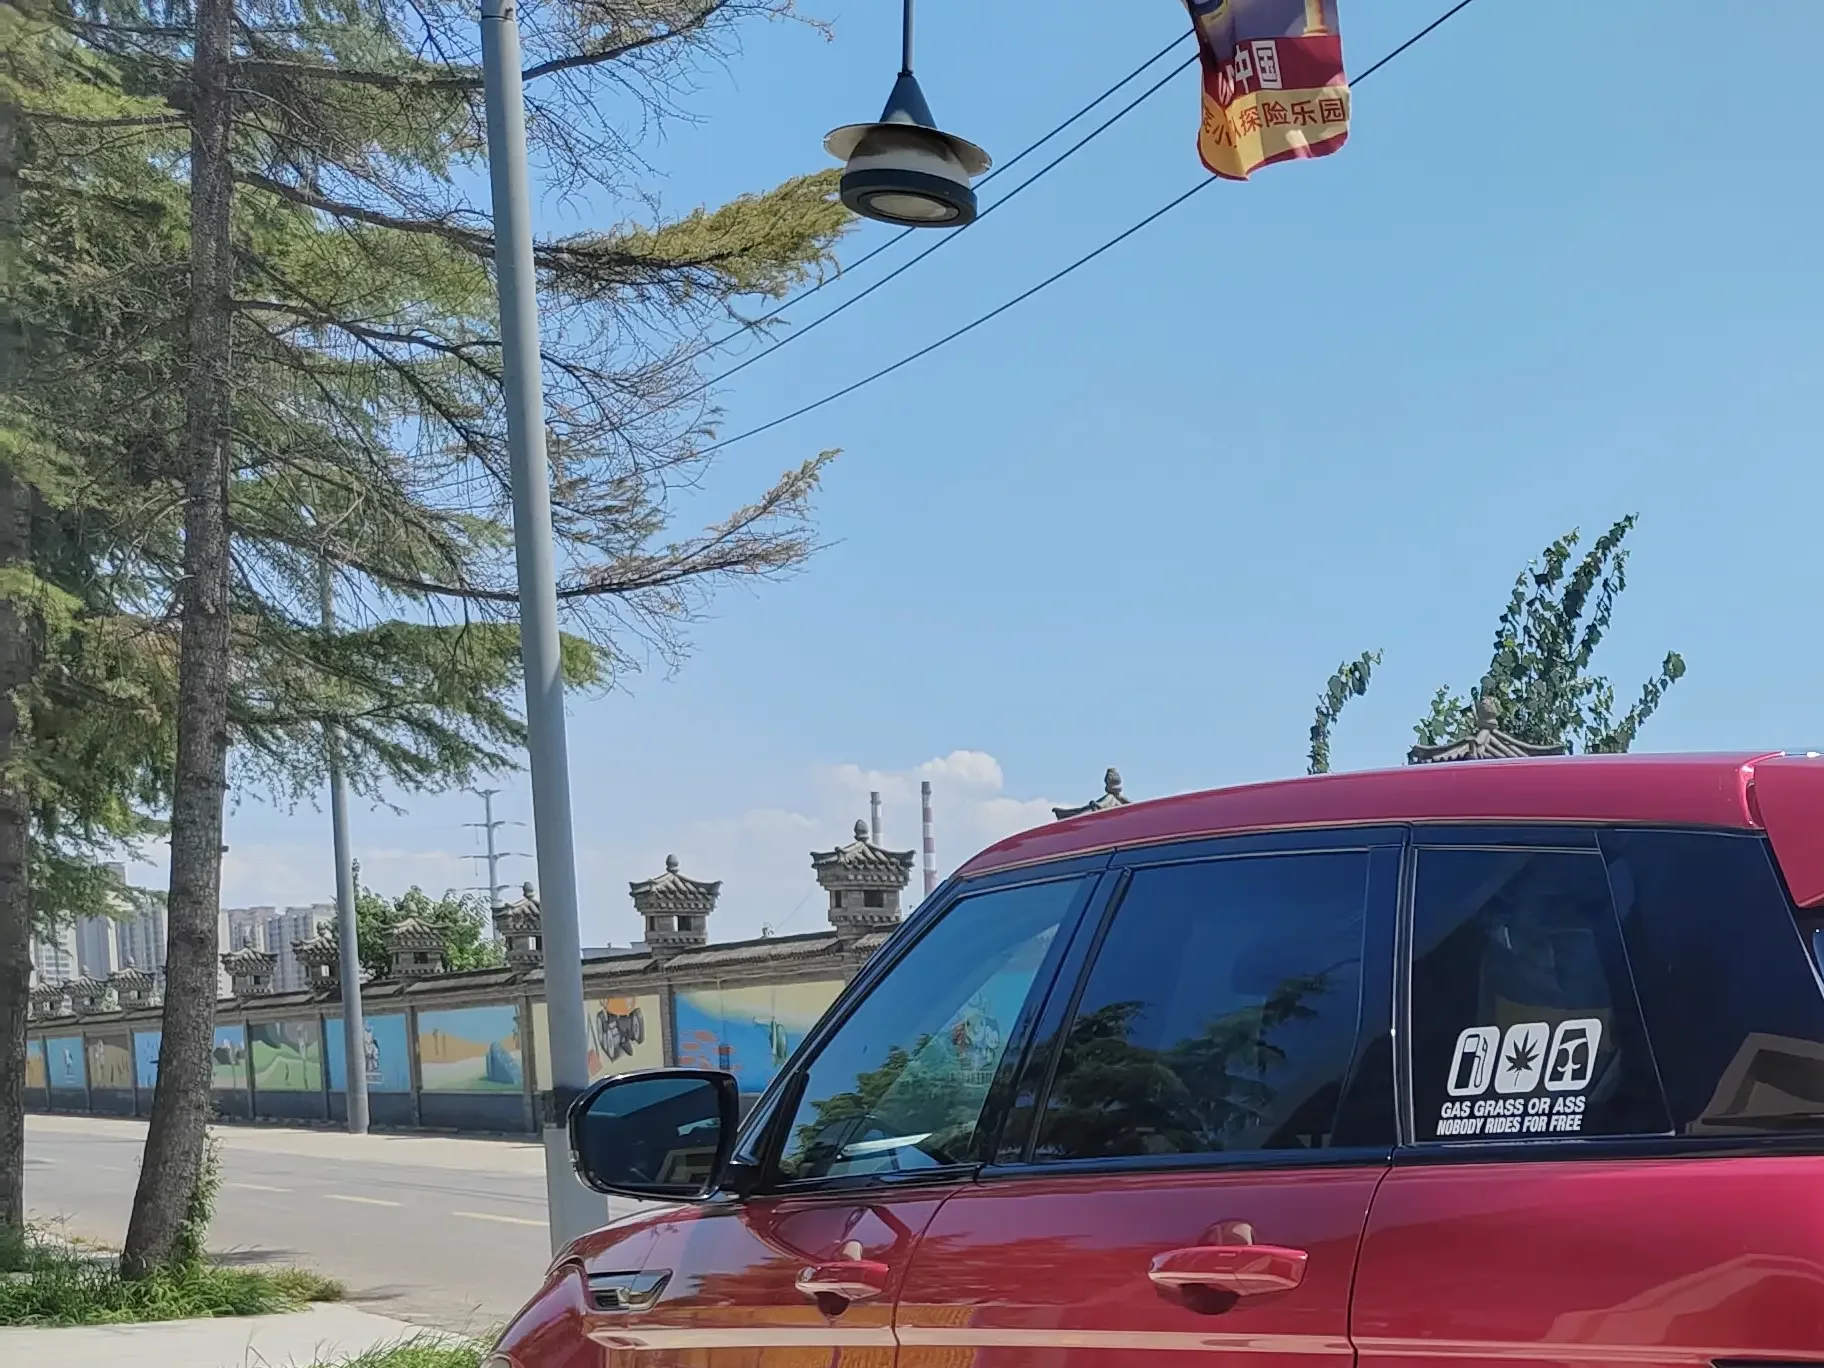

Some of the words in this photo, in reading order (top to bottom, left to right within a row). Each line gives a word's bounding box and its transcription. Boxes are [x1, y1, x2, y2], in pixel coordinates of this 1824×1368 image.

[1218, 40, 1283, 105] 中国
[1441, 1101, 1471, 1117] GAS
[1474, 1099, 1524, 1116] GRASS
[1527, 1098, 1551, 1115] OR
[1552, 1096, 1586, 1114] ASS
[1436, 1118, 1484, 1135] NOBODY
[1485, 1117, 1521, 1133] RIDES
[1522, 1116, 1548, 1132] FOR
[1549, 1115, 1583, 1131] FREE
